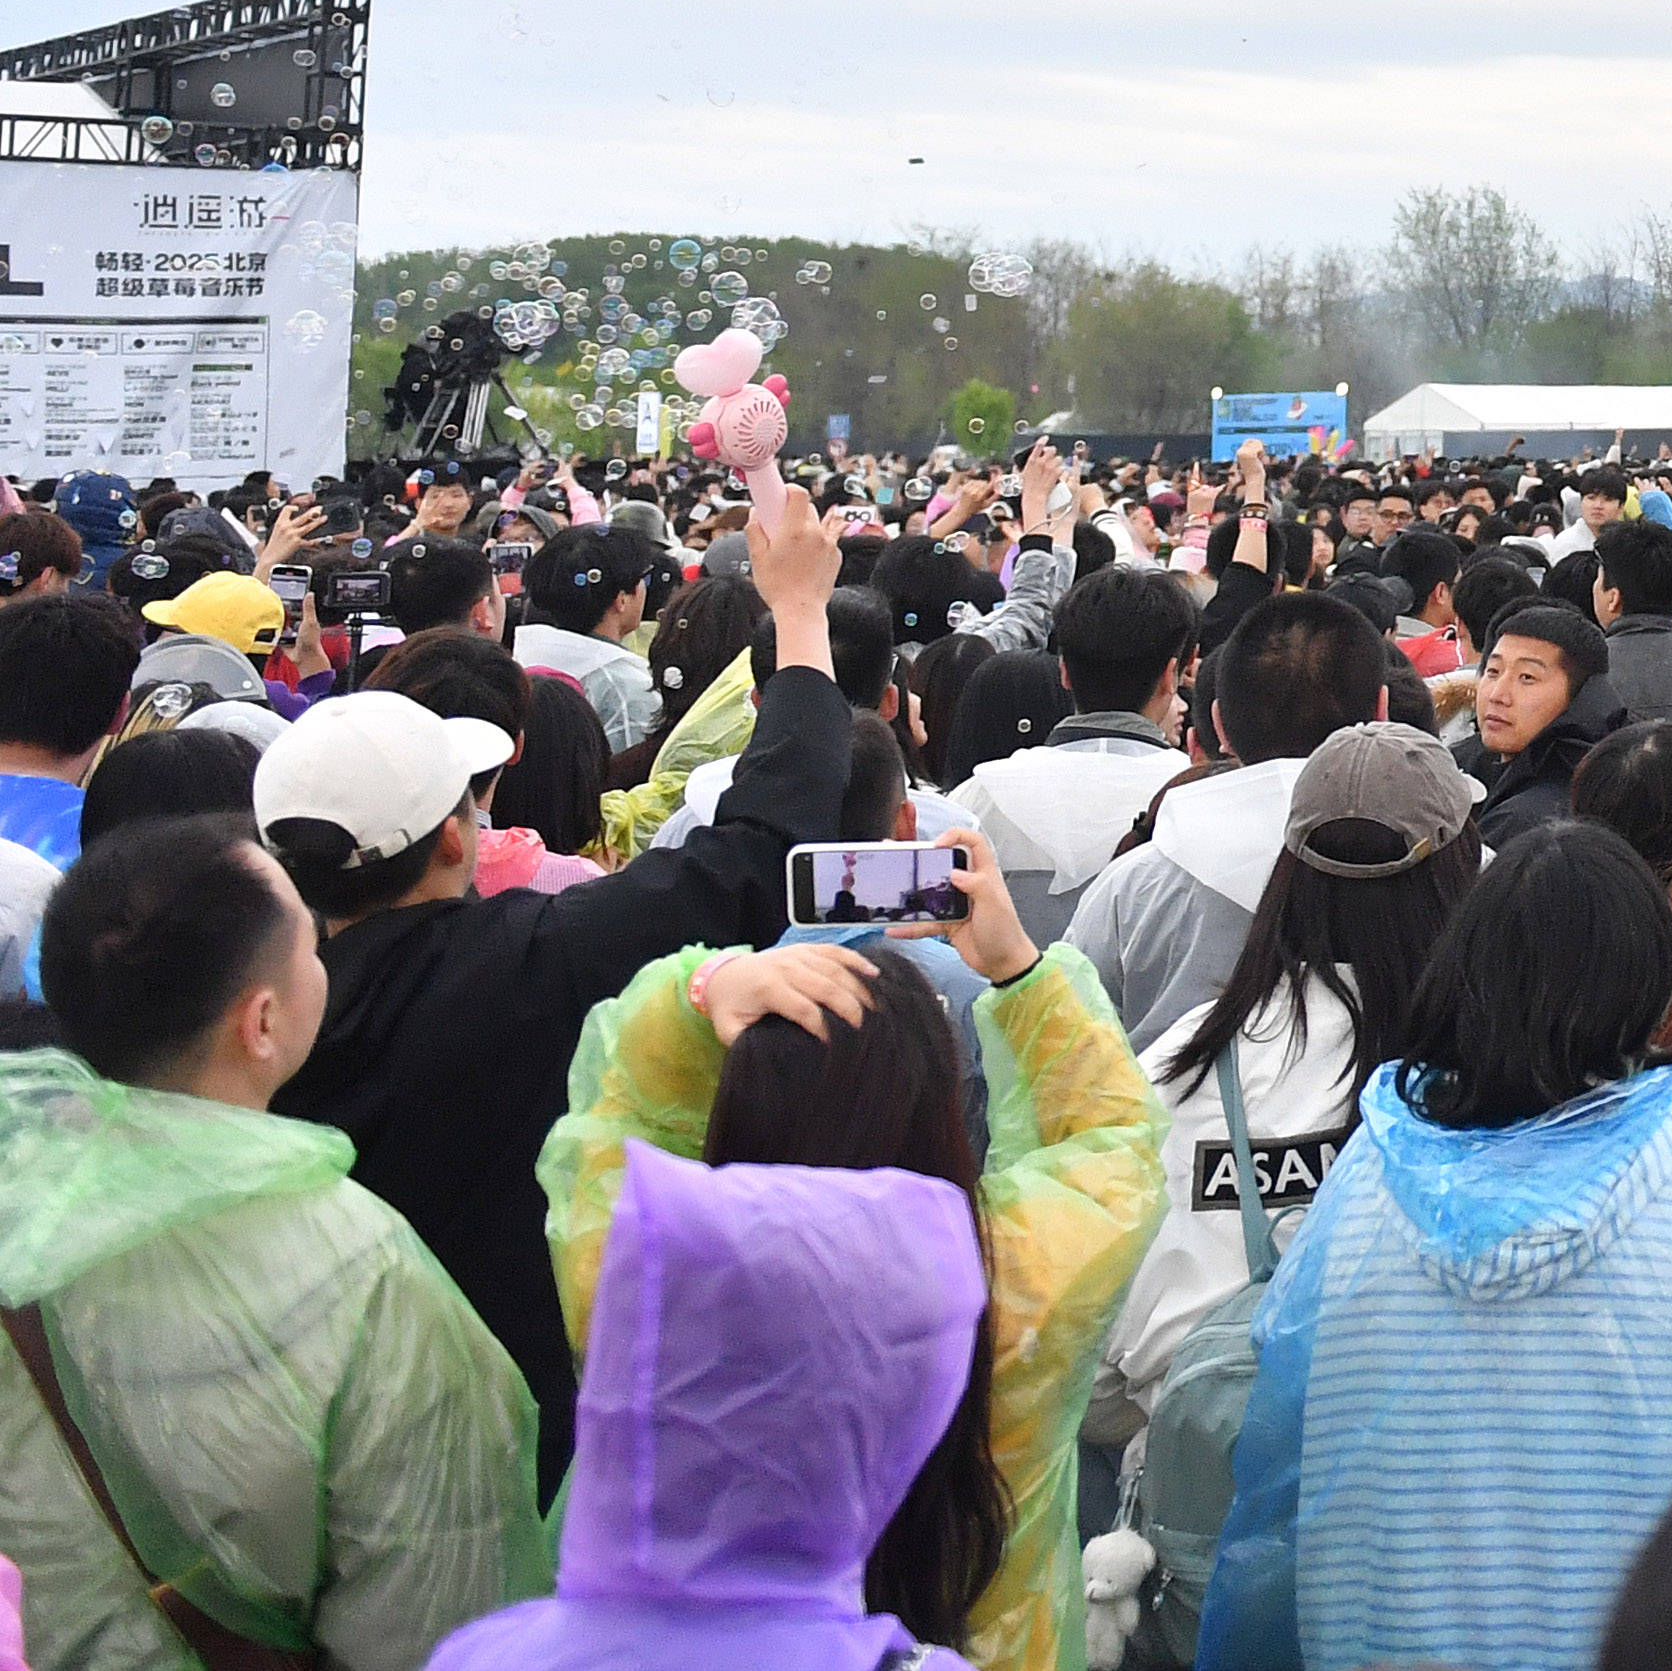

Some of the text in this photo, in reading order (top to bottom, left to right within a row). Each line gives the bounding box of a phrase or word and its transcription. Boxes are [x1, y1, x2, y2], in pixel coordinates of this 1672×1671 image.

[95, 277, 265, 298] 超级草莓音乐节
